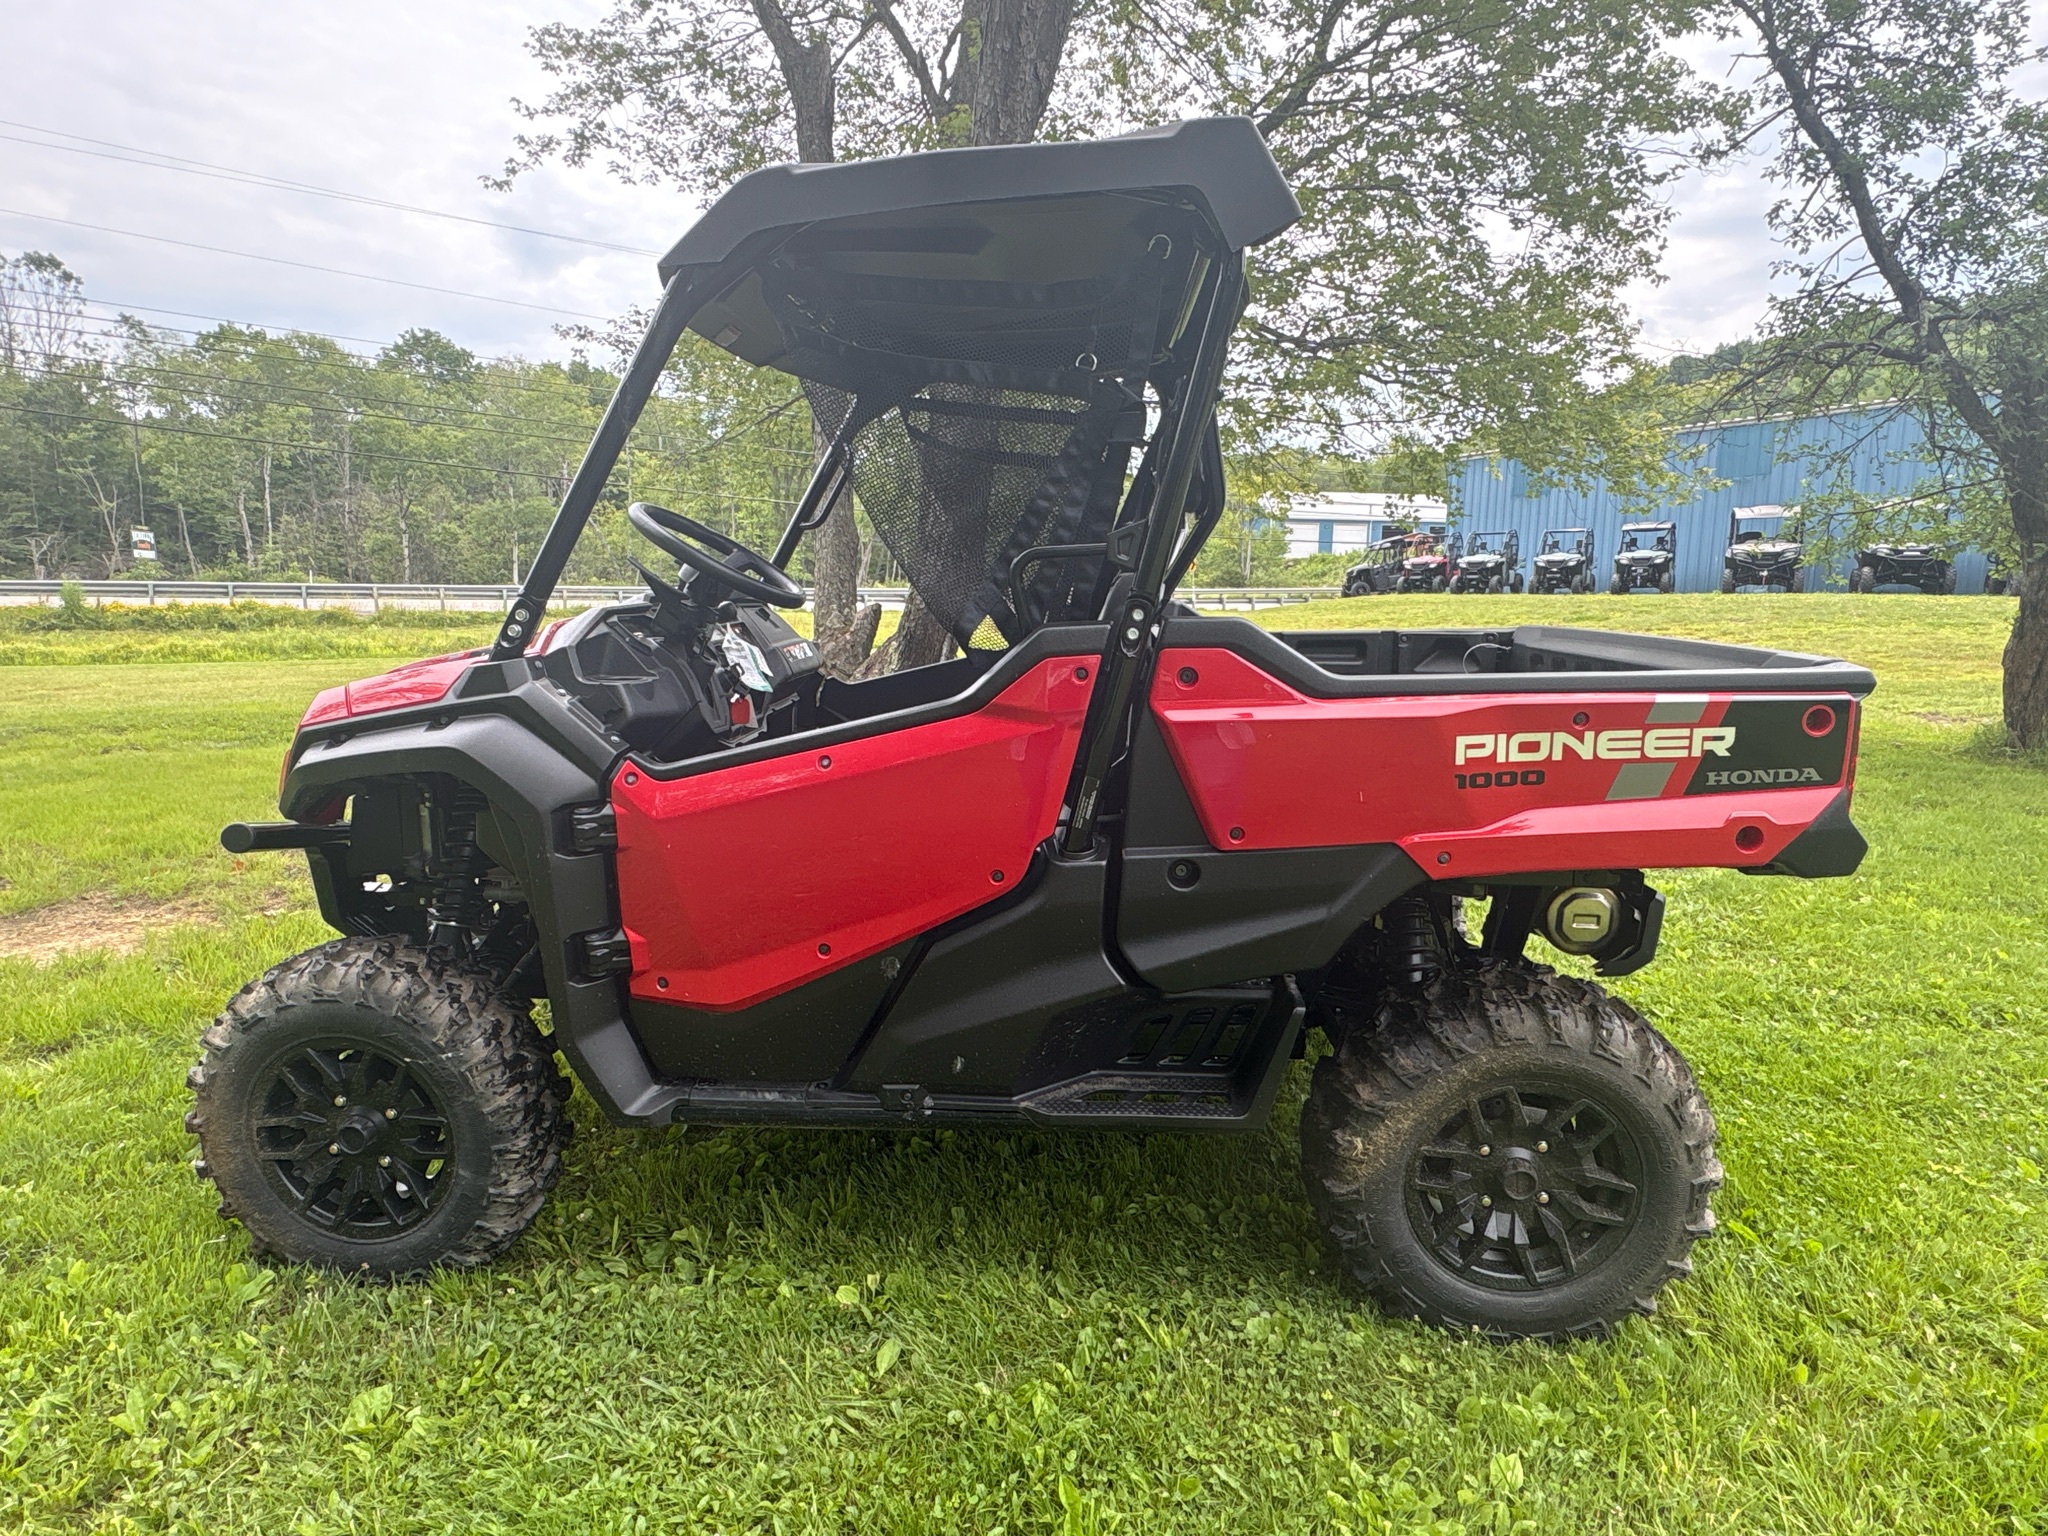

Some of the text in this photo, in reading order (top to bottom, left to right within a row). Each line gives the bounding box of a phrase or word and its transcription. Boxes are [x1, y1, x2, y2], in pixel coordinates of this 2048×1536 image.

[1455, 727, 1736, 765] PIONEER
[1454, 770, 1545, 789] 1000
[1706, 768, 1823, 785] HONDA
